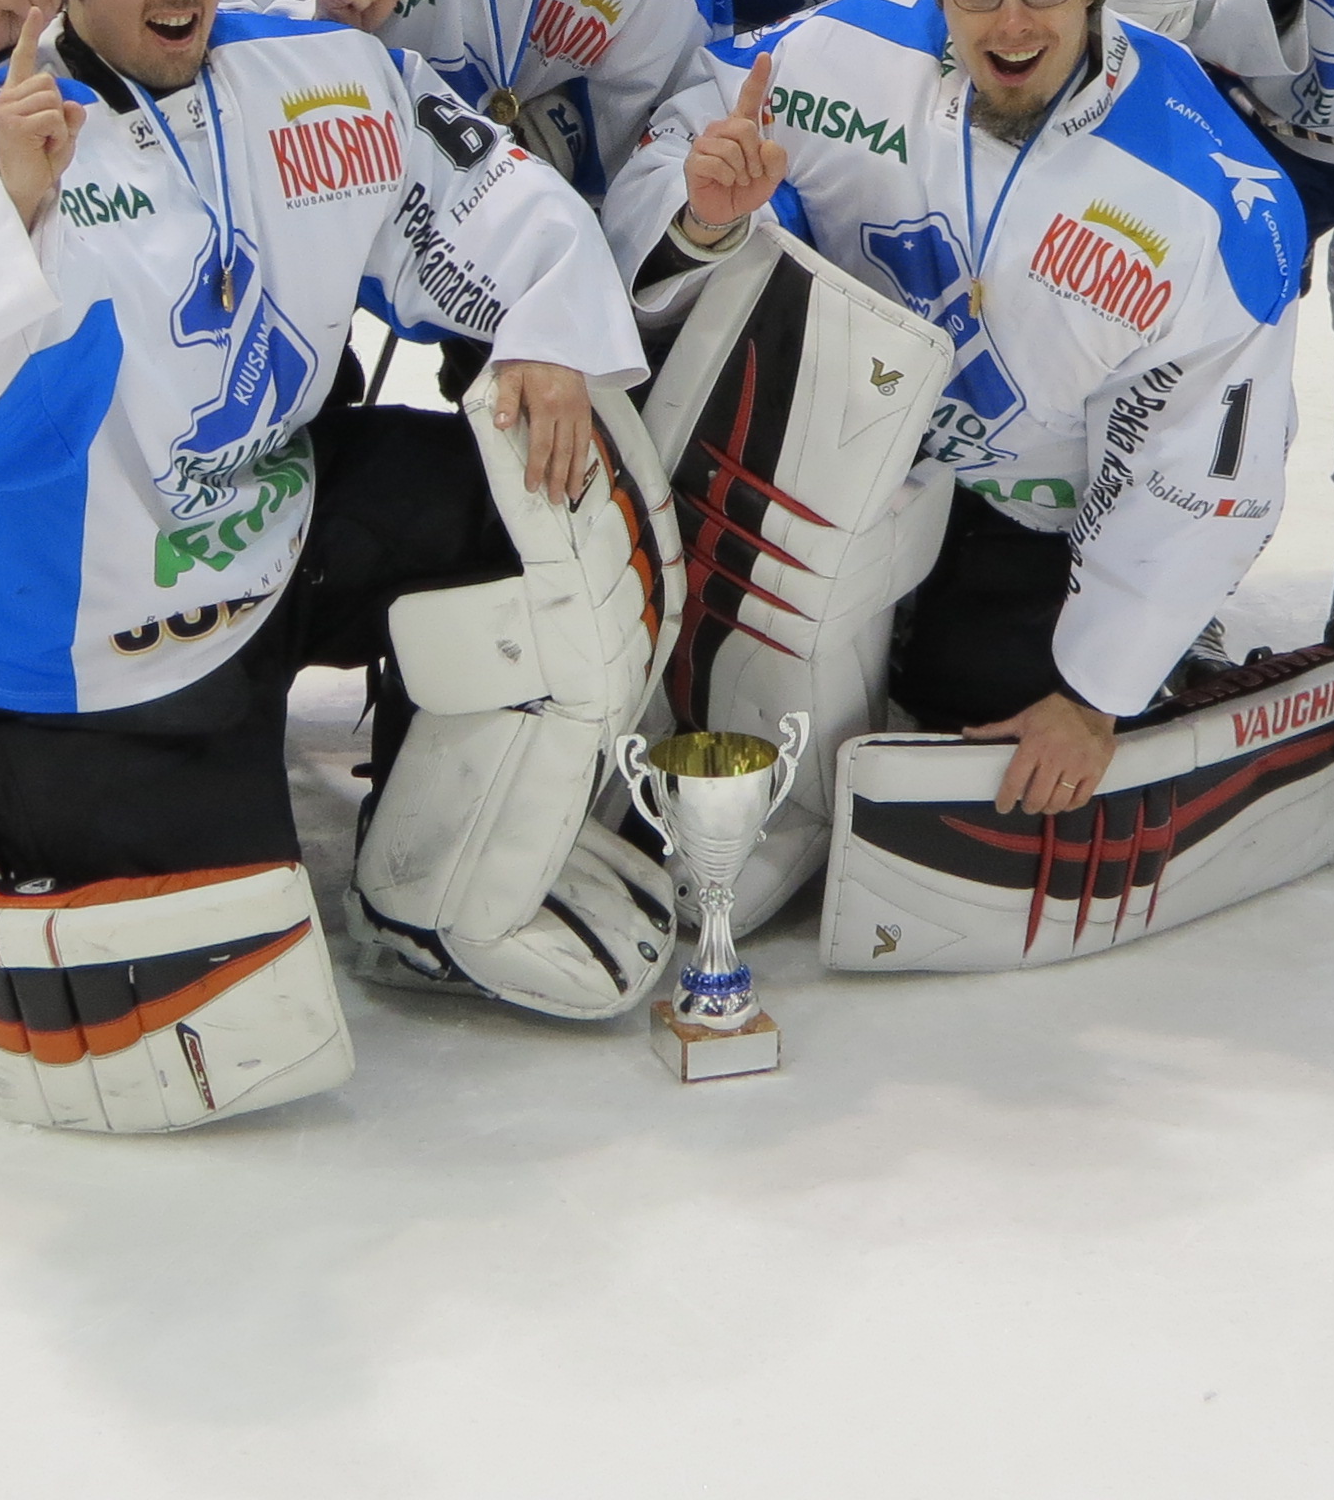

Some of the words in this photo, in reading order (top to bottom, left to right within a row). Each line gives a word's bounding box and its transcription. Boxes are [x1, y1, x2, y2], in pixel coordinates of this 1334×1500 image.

[769, 85, 909, 166] PRISMA
[1061, 91, 1114, 137] Holiday
[1106, 34, 1129, 74] Club
[286, 188, 353, 210] KUUSAMON
[450, 156, 516, 226] Holiday
[1030, 212, 1172, 334] KUUSAMO
[1207, 378, 1254, 481] 1
[1145, 469, 1215, 520] Holiday
[1232, 498, 1272, 519] Club
